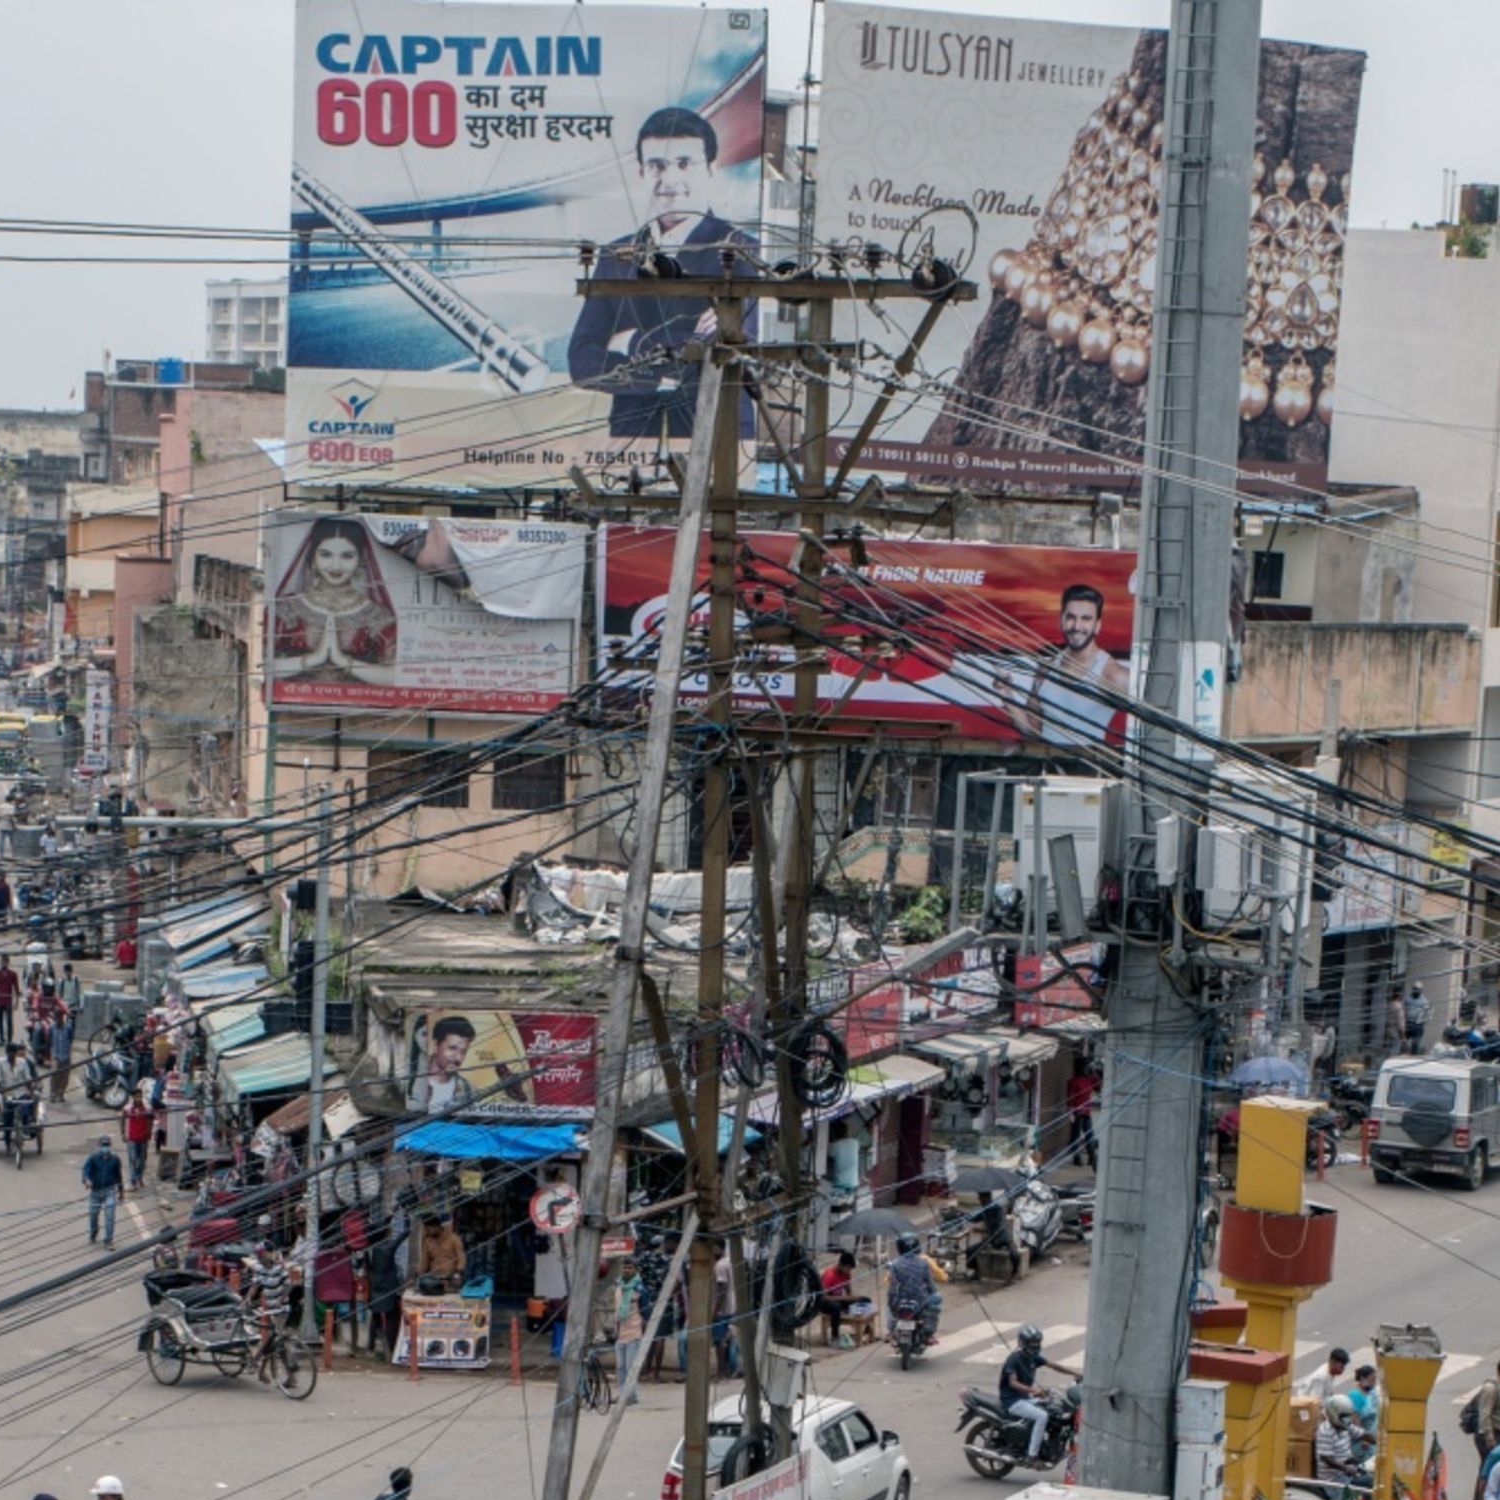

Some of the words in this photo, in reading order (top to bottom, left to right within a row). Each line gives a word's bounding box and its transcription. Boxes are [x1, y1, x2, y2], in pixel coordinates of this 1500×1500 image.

[316, 33, 601, 76] CAPTAIN
[887, 26, 1014, 82] TULSYAN
[1017, 61, 1106, 88] JEWELLERY
[465, 85, 499, 108] का
[510, 85, 547, 111] दम
[317, 78, 457, 148] 600
[465, 114, 538, 149] सुरक्षा
[545, 115, 613, 142] हरदम
[849, 184, 862, 201] A
[972, 188, 1042, 218] Made
[848, 211, 866, 227] to
[871, 213, 923, 233] touch
[308, 420, 395, 435] CAPTAIN
[308, 439, 356, 462] 600
[464, 450, 535, 467] Helpline
[541, 450, 564, 464] No
[872, 565, 918, 582] FROM
[923, 568, 986, 585] NATURE
